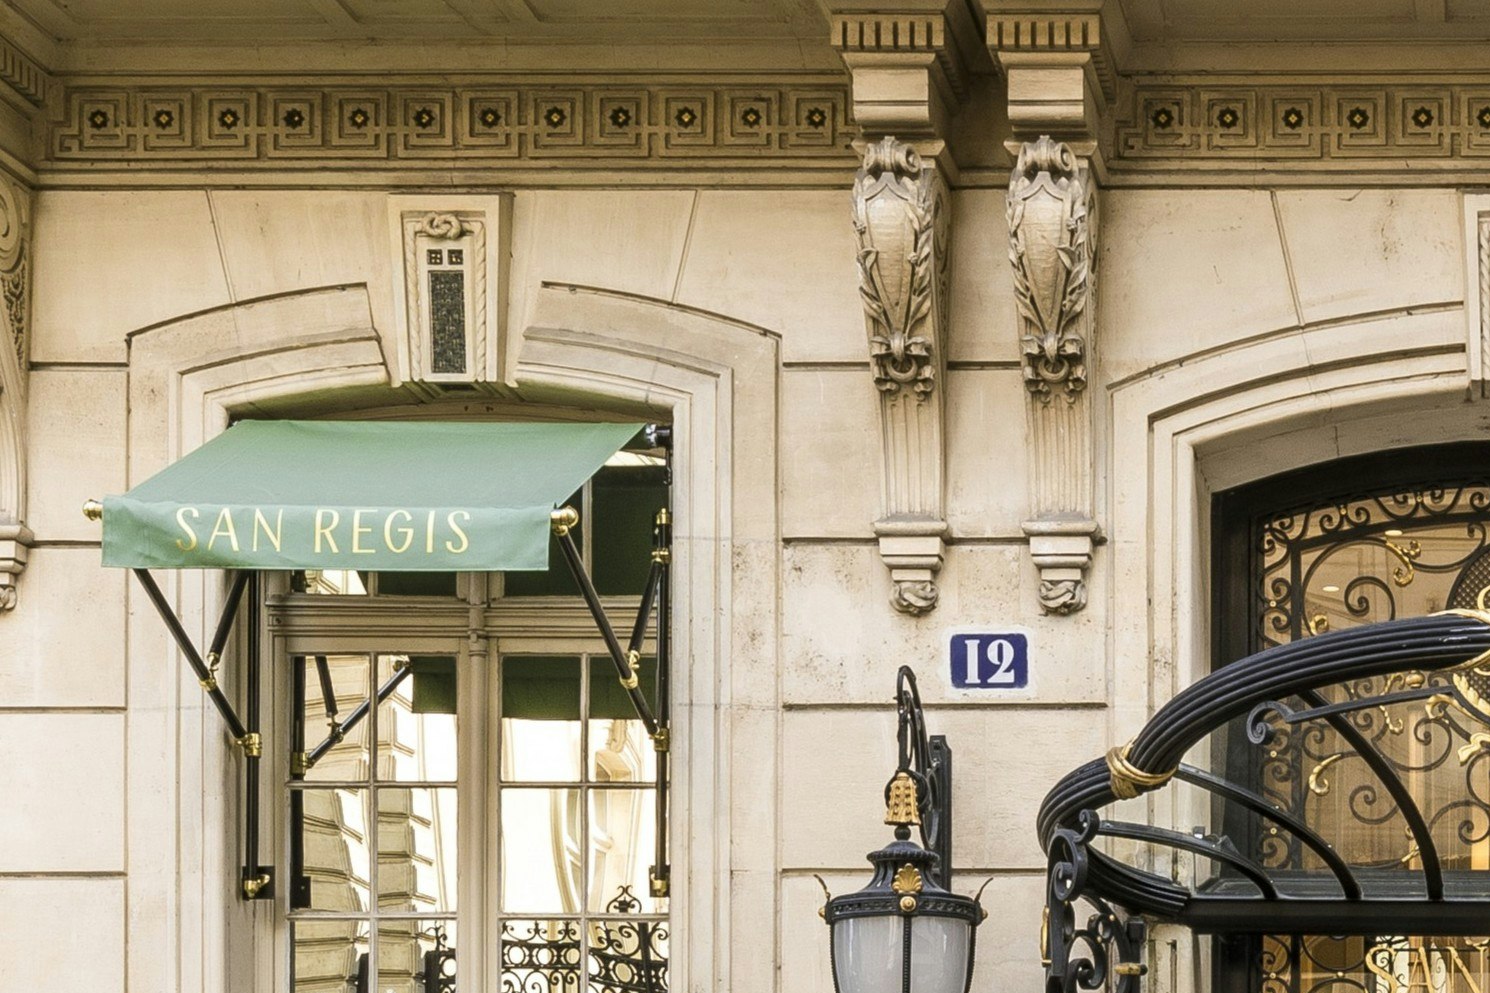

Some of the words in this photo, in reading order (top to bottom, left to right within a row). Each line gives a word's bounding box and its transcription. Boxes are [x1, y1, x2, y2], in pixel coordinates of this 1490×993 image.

[175, 508, 283, 553] SAN
[314, 509, 471, 554] REGIS
[964, 639, 1014, 683] 12
